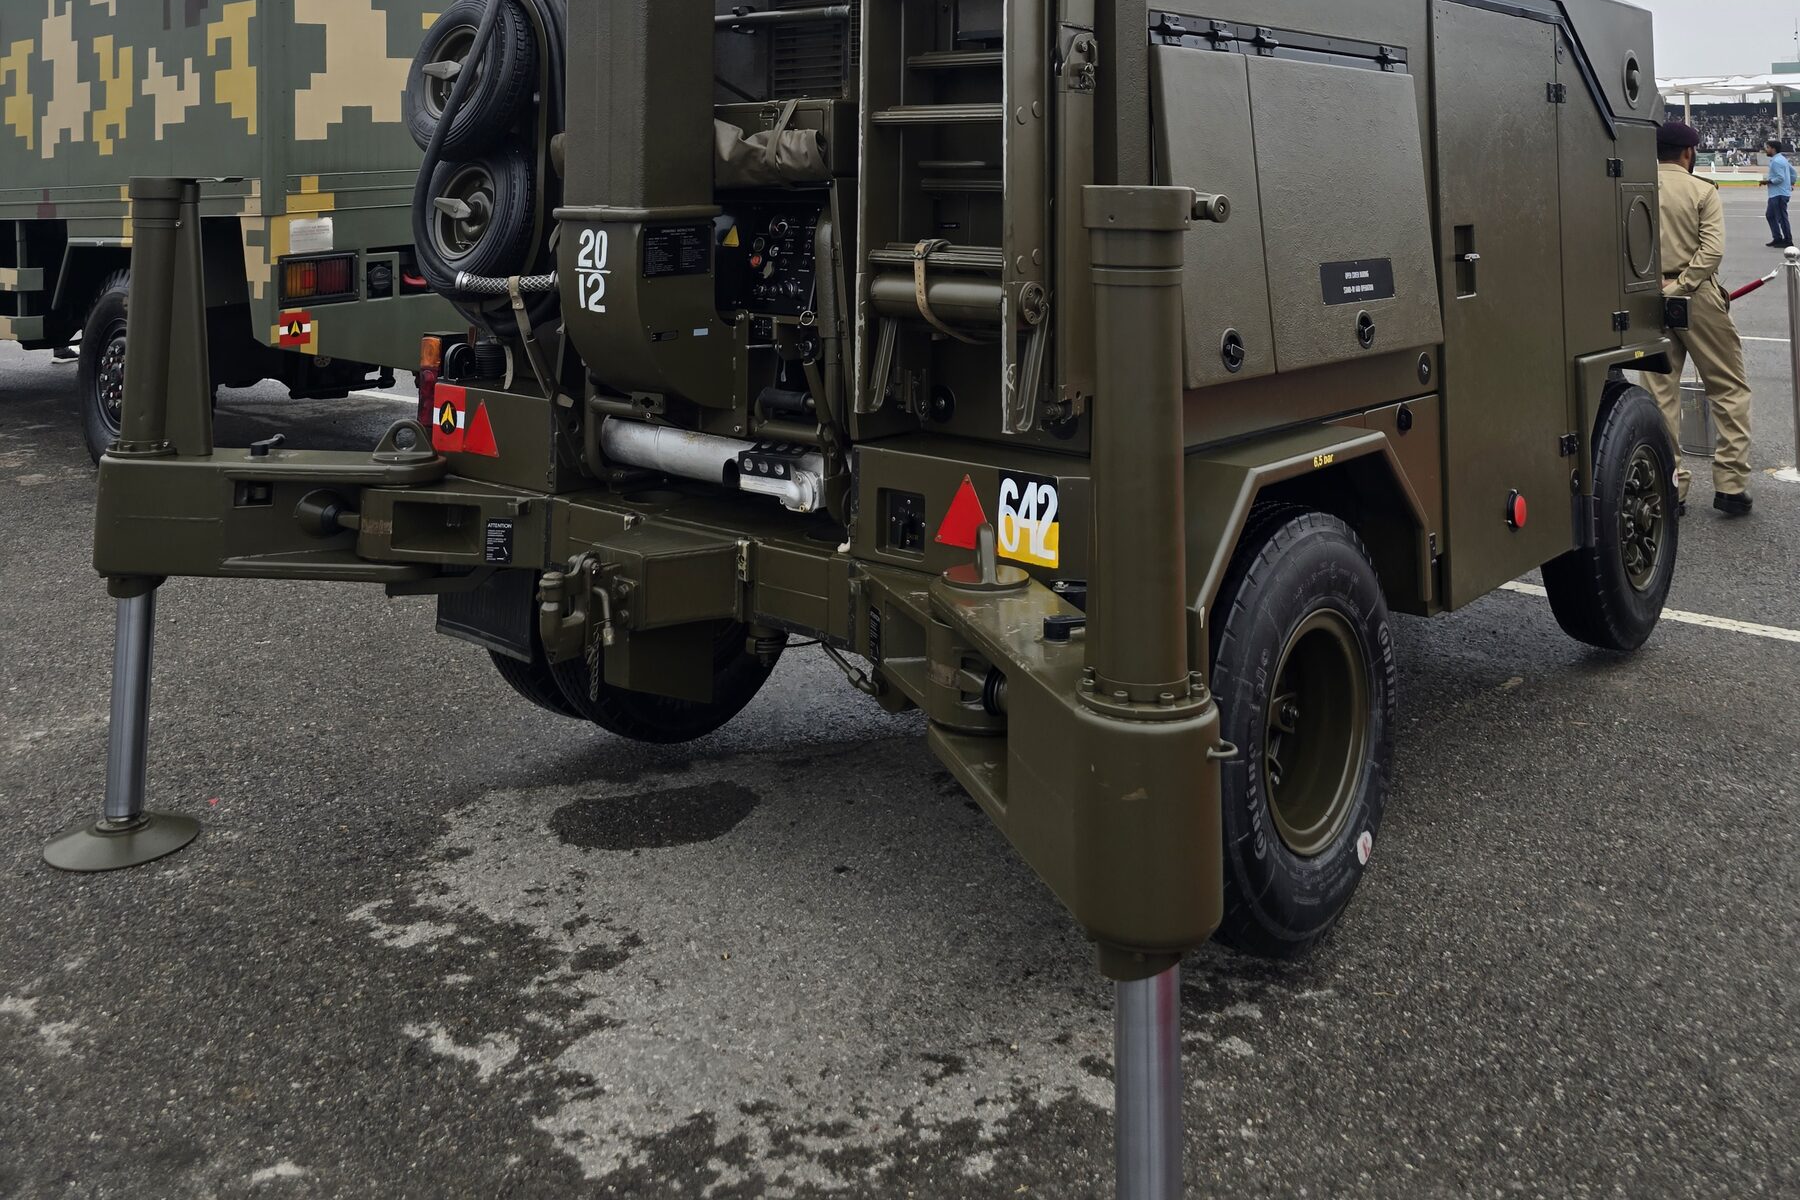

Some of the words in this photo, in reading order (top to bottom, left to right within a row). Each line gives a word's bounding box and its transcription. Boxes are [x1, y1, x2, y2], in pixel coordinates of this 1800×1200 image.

[578, 228, 608, 269] 20
[579, 273, 606, 313] 12
[1324, 454, 1334, 465] bar
[998, 477, 1058, 560] 642
